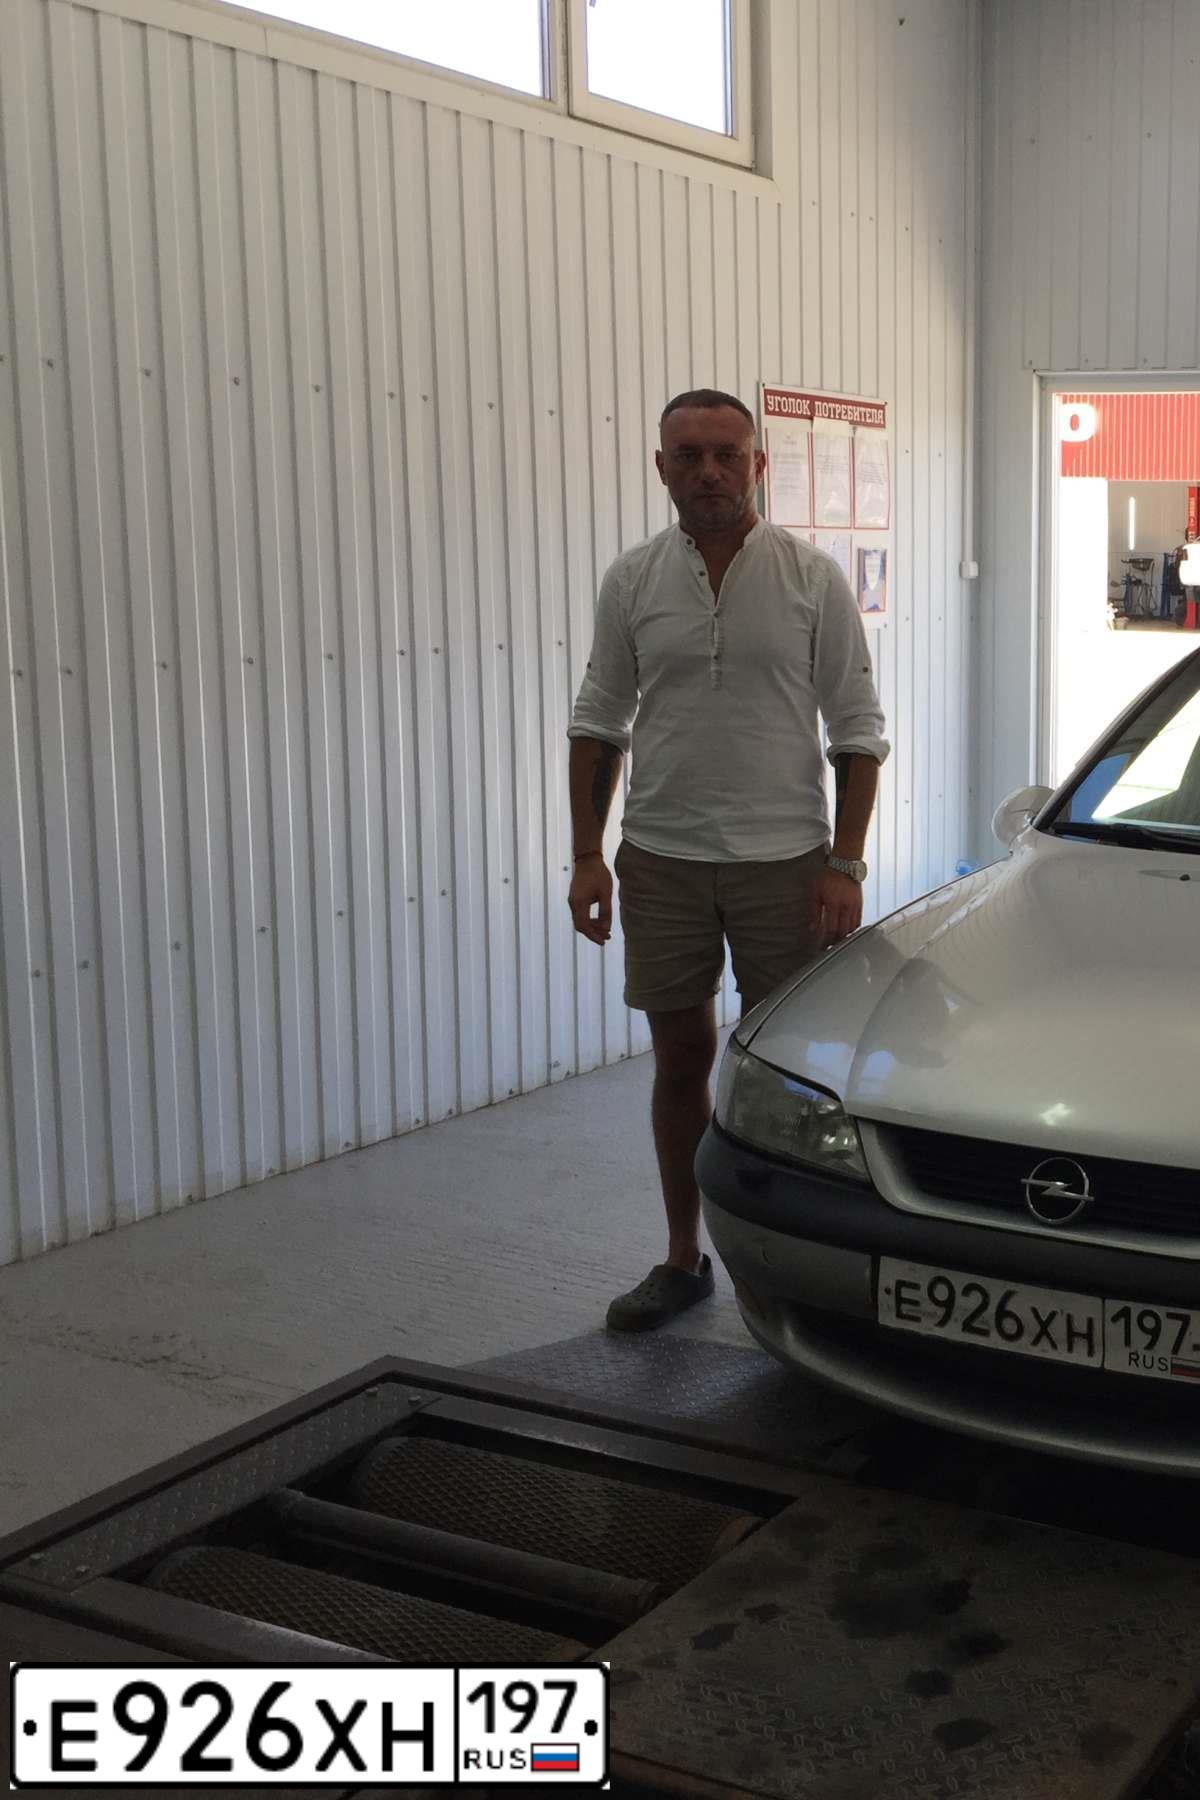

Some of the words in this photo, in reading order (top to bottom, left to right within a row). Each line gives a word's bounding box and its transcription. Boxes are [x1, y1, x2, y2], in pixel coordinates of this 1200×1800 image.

[767, 394, 811, 416] УГОЛОК
[815, 400, 884, 425] ПОТРЕБИТЕЛЯ
[1110, 1305, 1191, 1355] 197
[1128, 1351, 1169, 1372] RUS
